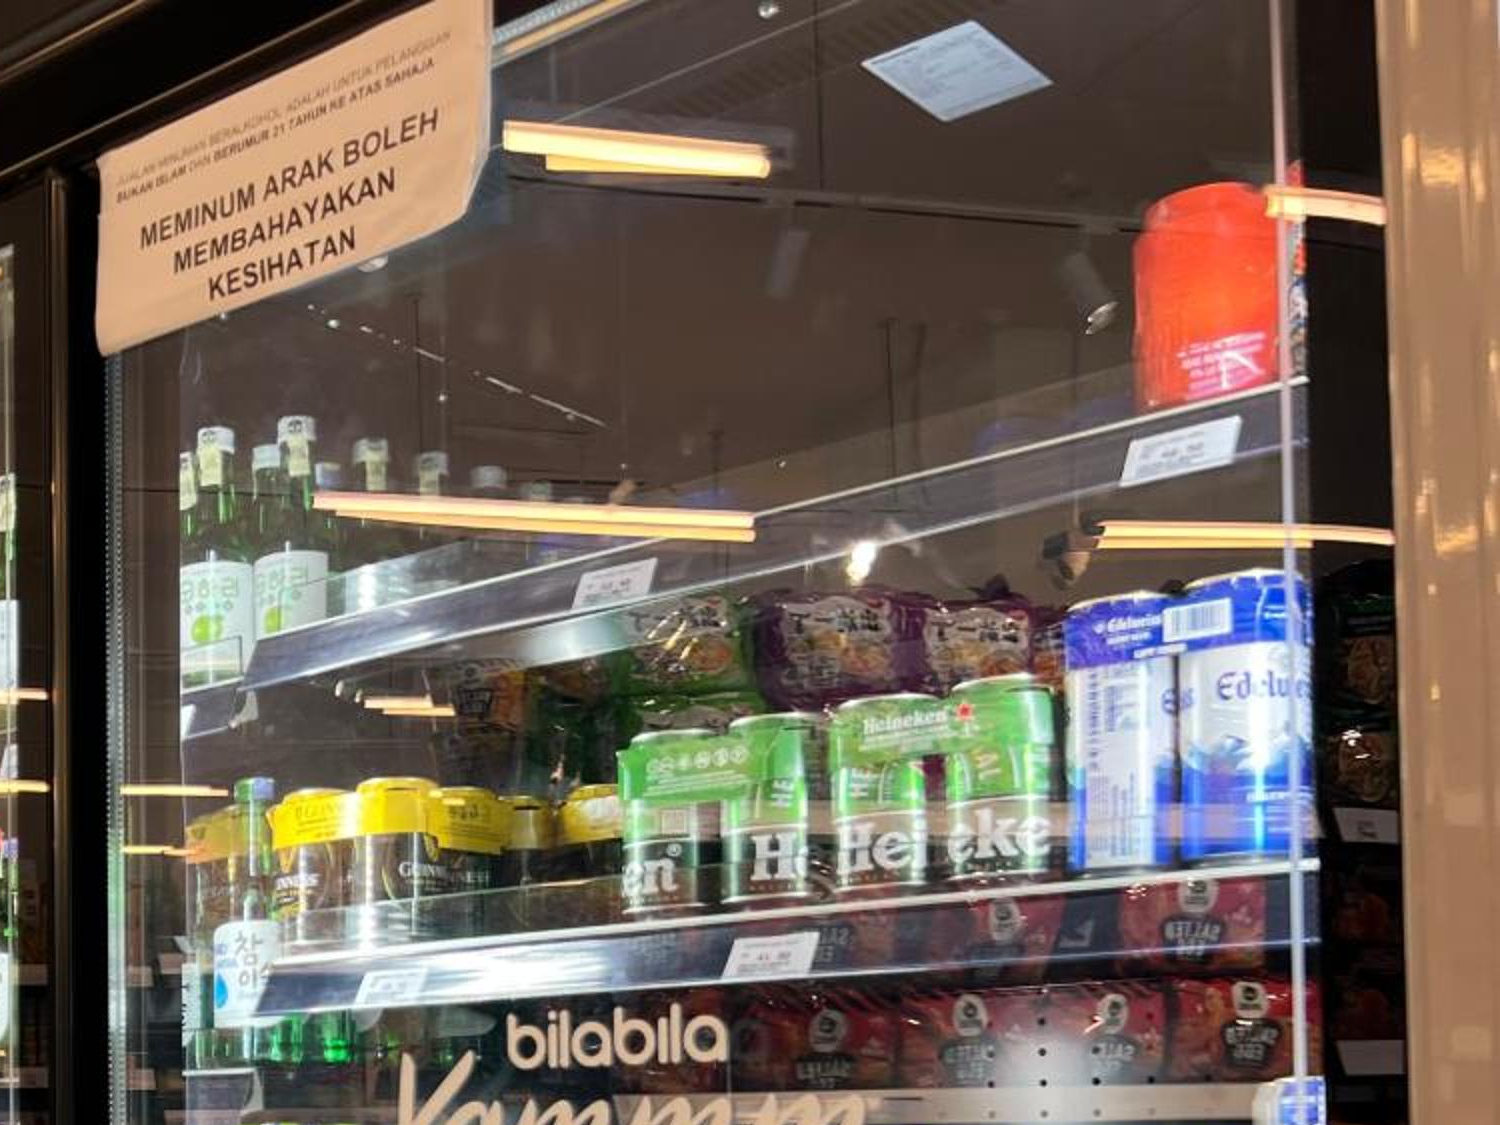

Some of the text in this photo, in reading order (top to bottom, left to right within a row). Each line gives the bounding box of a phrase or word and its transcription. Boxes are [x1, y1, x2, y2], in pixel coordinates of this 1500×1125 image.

[116, 180, 154, 204] BUKAN
[155, 163, 188, 188] ISLAM
[213, 129, 270, 162] BERUMUR
[288, 103, 328, 130] TAHUN
[328, 94, 347, 113] KE
[347, 79, 383, 105] ATAS
[384, 56, 436, 89] SAHAJA
[139, 106, 441, 251] MEMINUM ARAK BOLEH
[171, 165, 398, 277] MEMBAHAYAKAN
[206, 225, 359, 302] KESIHATAN
[863, 710, 948, 736] Heineken
[506, 1003, 730, 1071] bilabila
